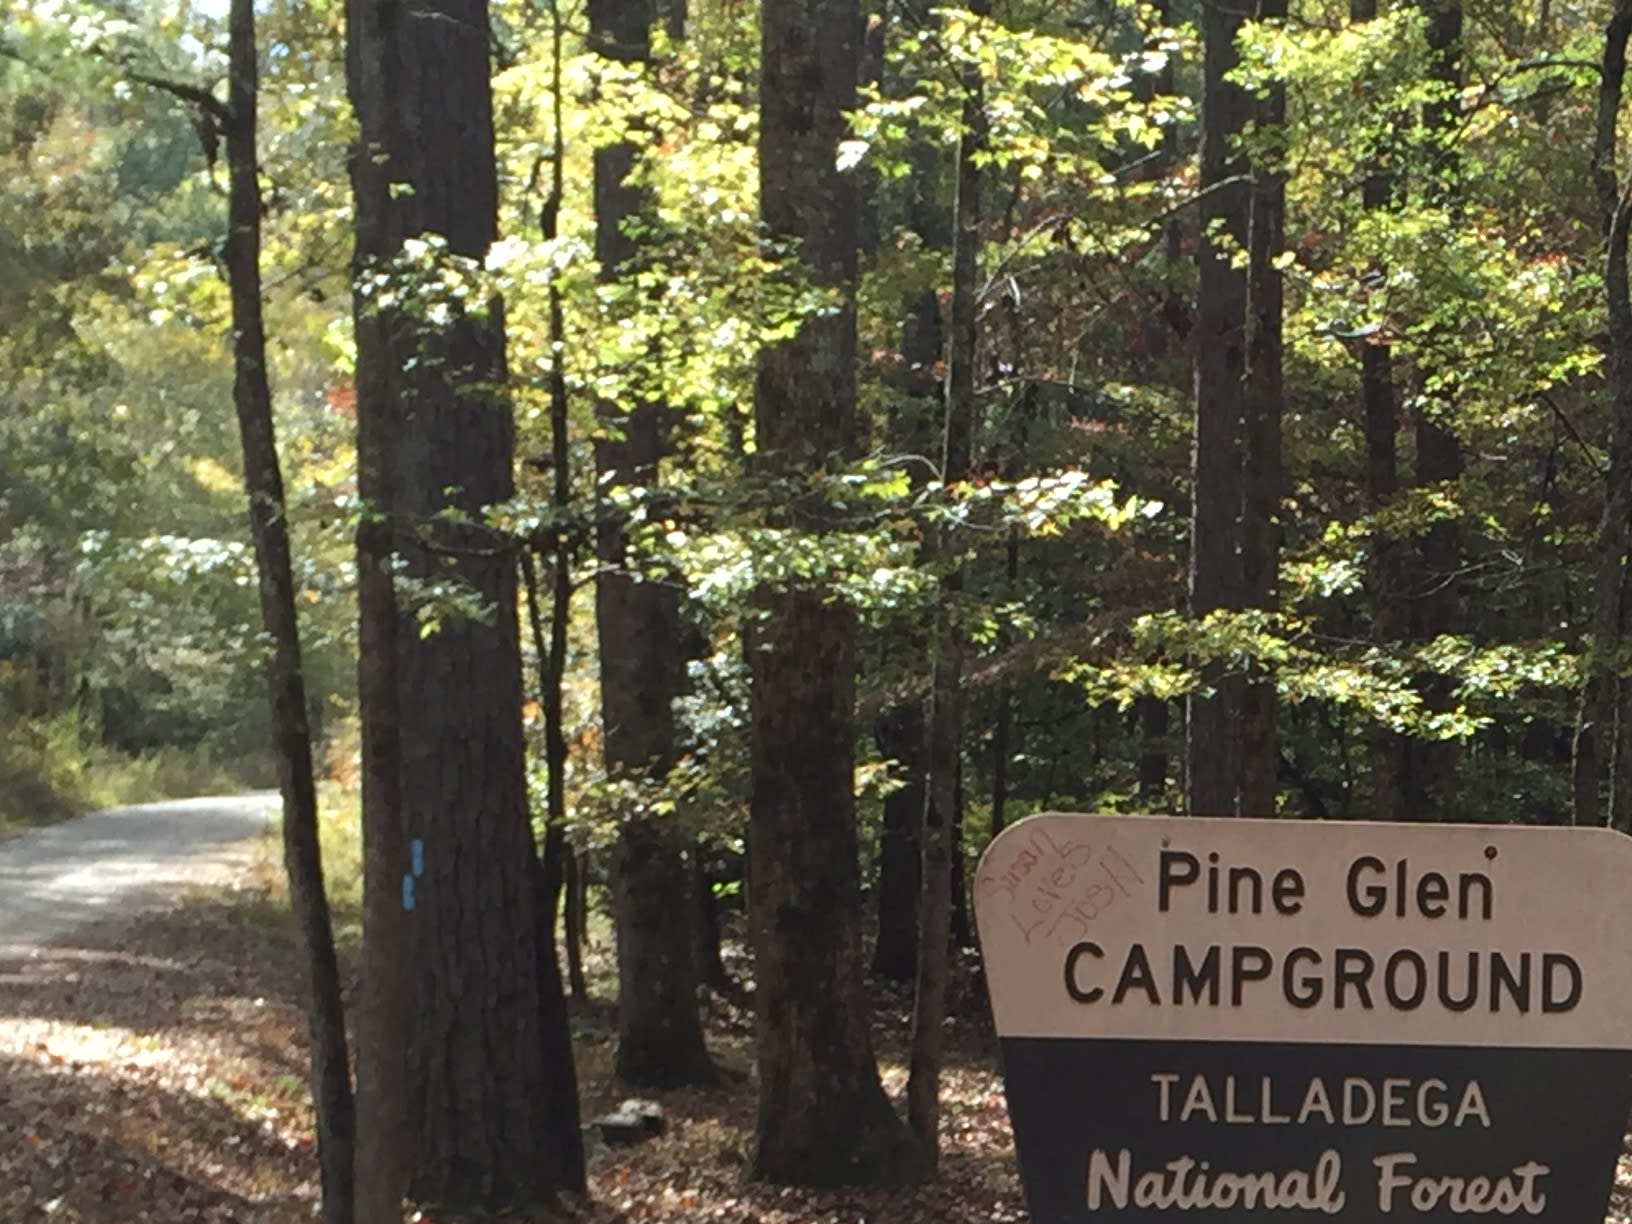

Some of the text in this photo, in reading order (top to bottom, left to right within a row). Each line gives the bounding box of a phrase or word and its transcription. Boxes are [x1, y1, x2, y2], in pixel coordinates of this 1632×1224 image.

[1158, 849, 1493, 920] Pine Glen
[1063, 941, 1584, 1015] CAMPGROUND
[1150, 1073, 1491, 1128] TALLADEGA
[1086, 1148, 1551, 1216] National Forest
